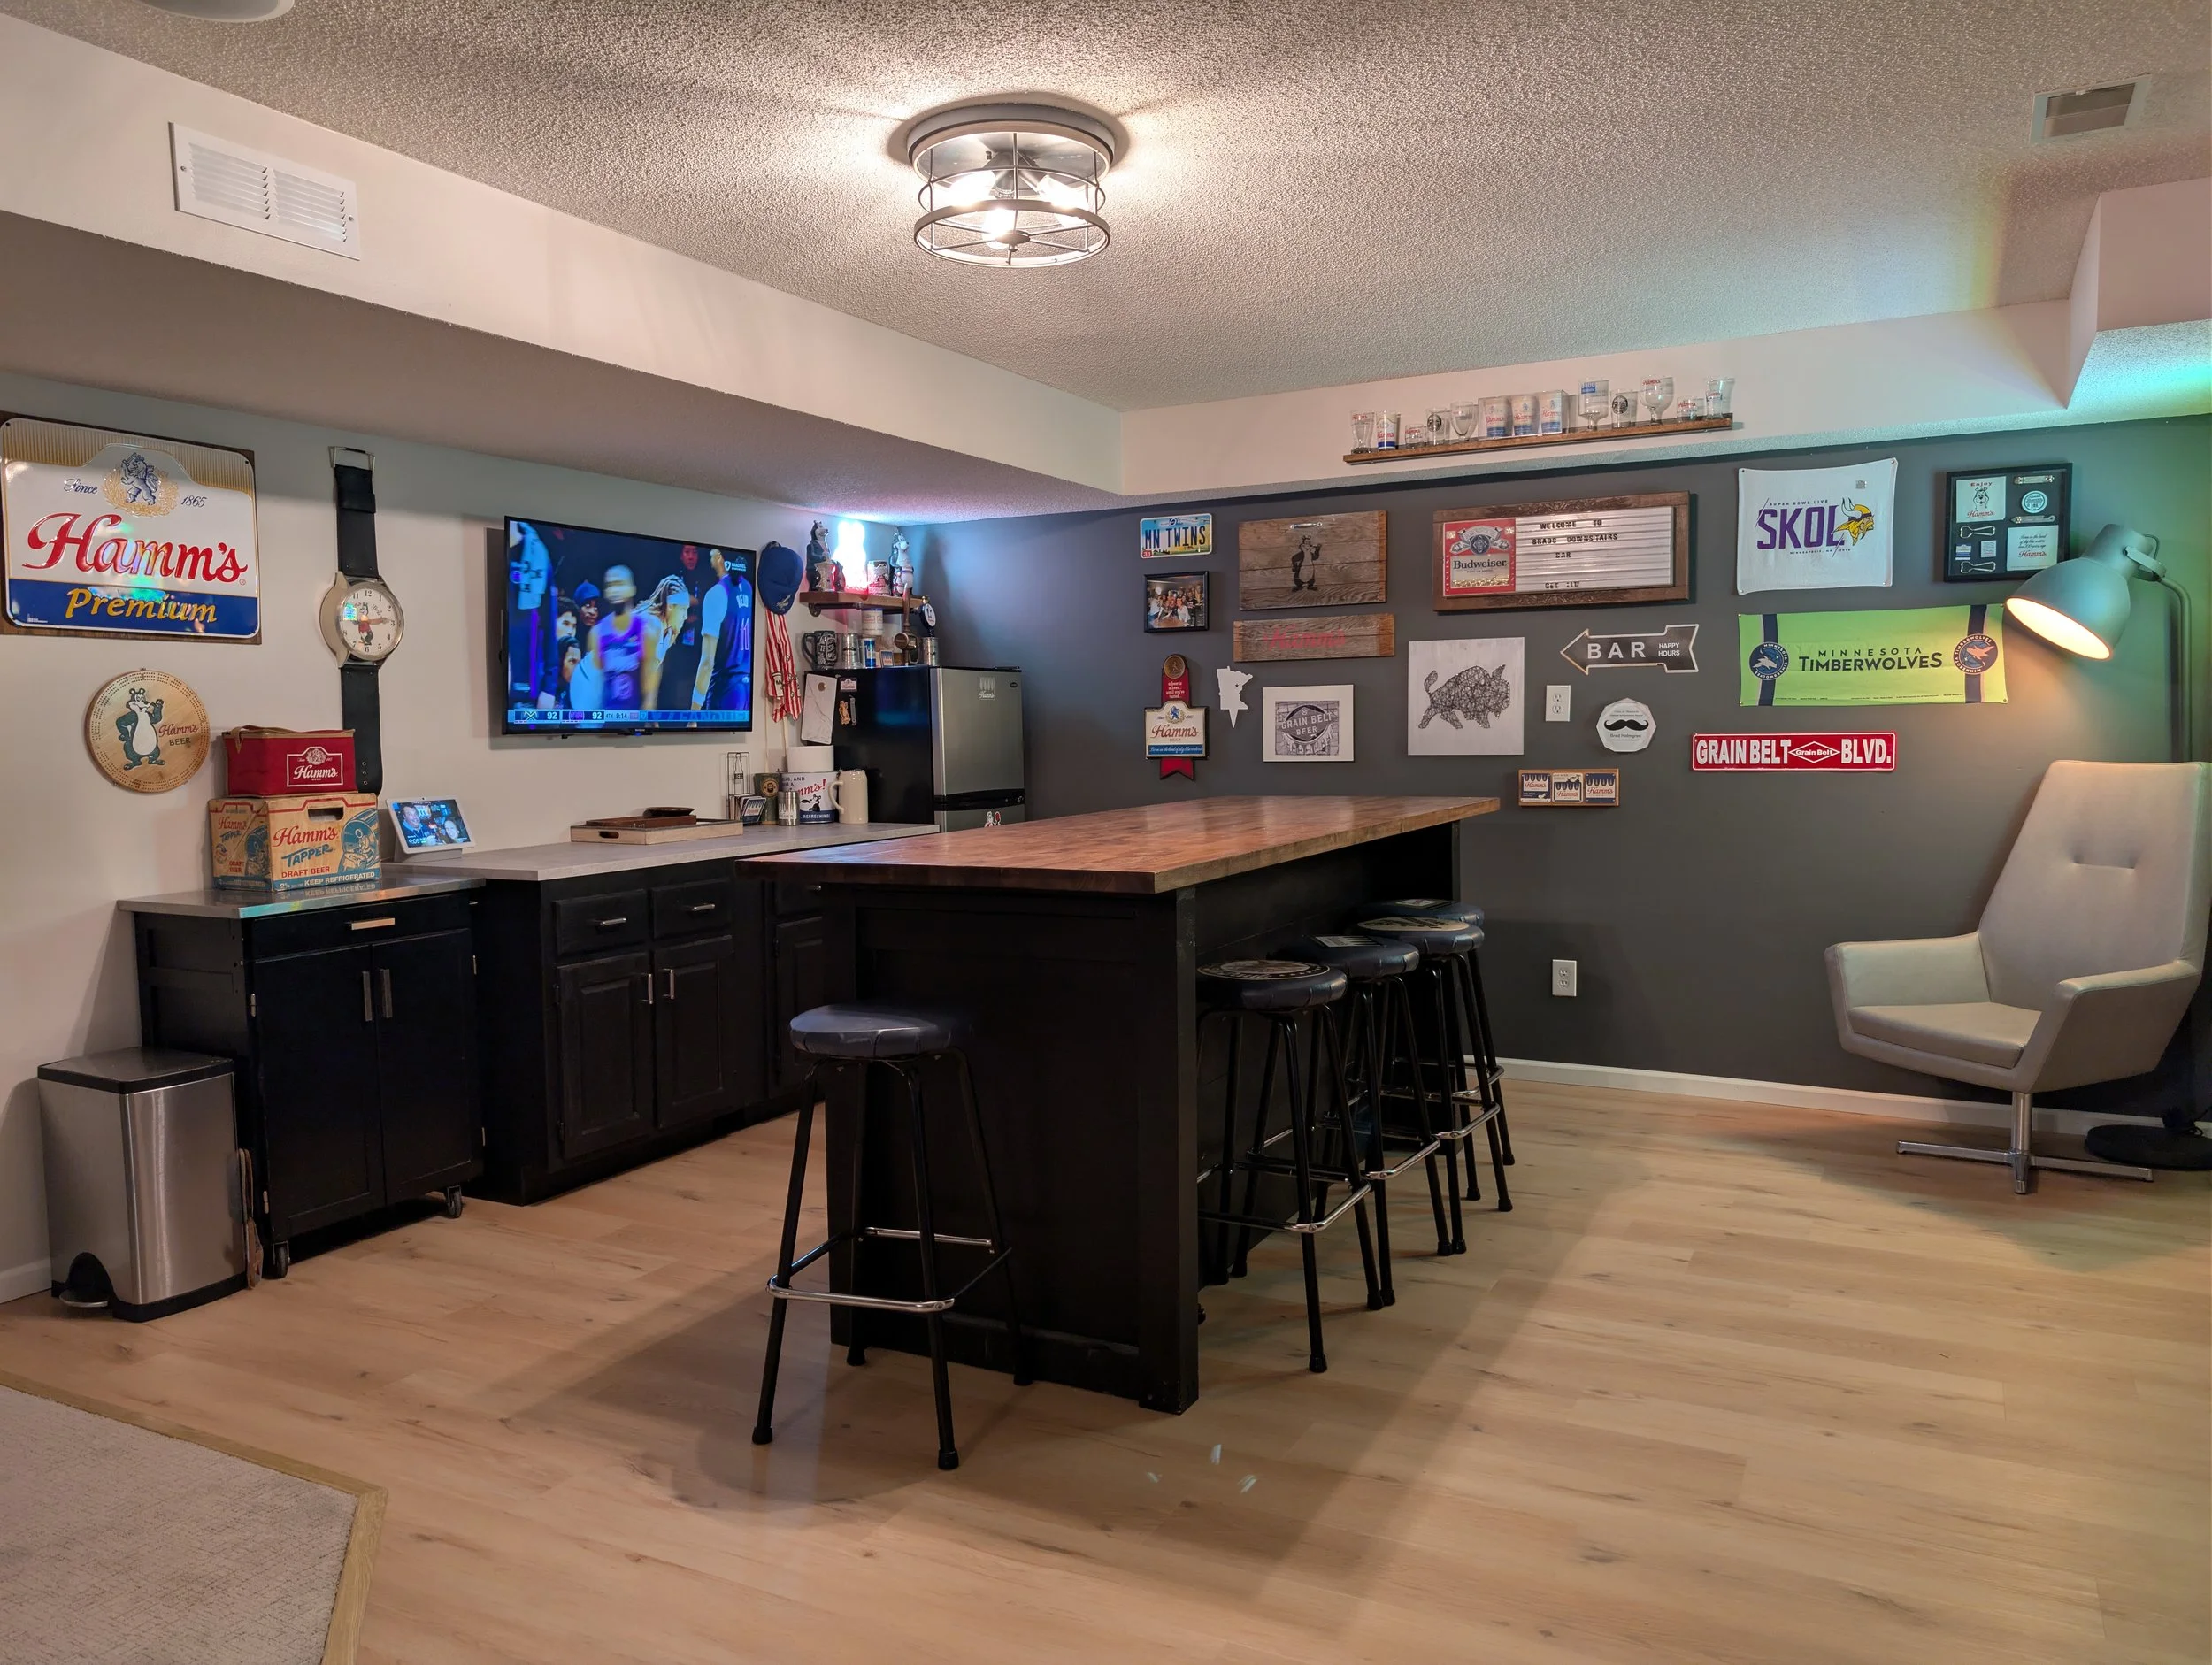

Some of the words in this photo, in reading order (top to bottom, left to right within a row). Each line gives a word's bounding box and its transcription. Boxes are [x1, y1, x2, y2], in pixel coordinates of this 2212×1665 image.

[64, 478, 98, 495] Since
[180, 495, 207, 508] 1865
[1756, 504, 1845, 549] SKOL
[1145, 529, 1160, 549] MN
[1166, 526, 1206, 548] TWINS
[21, 512, 249, 584] Hamm's
[1453, 559, 1508, 569] Budweiser
[65, 587, 218, 624] Premium
[1587, 641, 1646, 659] BAR
[1818, 647, 1922, 657] MINNESOTA
[1799, 652, 1942, 671] TIMBERWOLVES
[547, 711, 557, 720] 92
[592, 711, 603, 720] 92
[1281, 717, 1308, 729] GRAIN
[1310, 712, 1332, 724] BELT
[158, 723, 199, 738] Hamm's
[1150, 724, 1199, 739] Hamm's
[1296, 726, 1317, 735] BEER
[169, 737, 191, 746] BEER
[1696, 740, 1747, 764] GRAIN
[1750, 739, 1792, 764] BELT
[1841, 739, 1891, 763] BLVD.
[293, 764, 339, 779] Hamm's
[797, 779, 826, 796] mm's!
[272, 825, 338, 847] Hamm's
[280, 843, 333, 867] TAPPER
[281, 869, 308, 878] DRAFT
[304, 878, 324, 886] KEEP
[325, 871, 375, 884] REFRIGERATED
